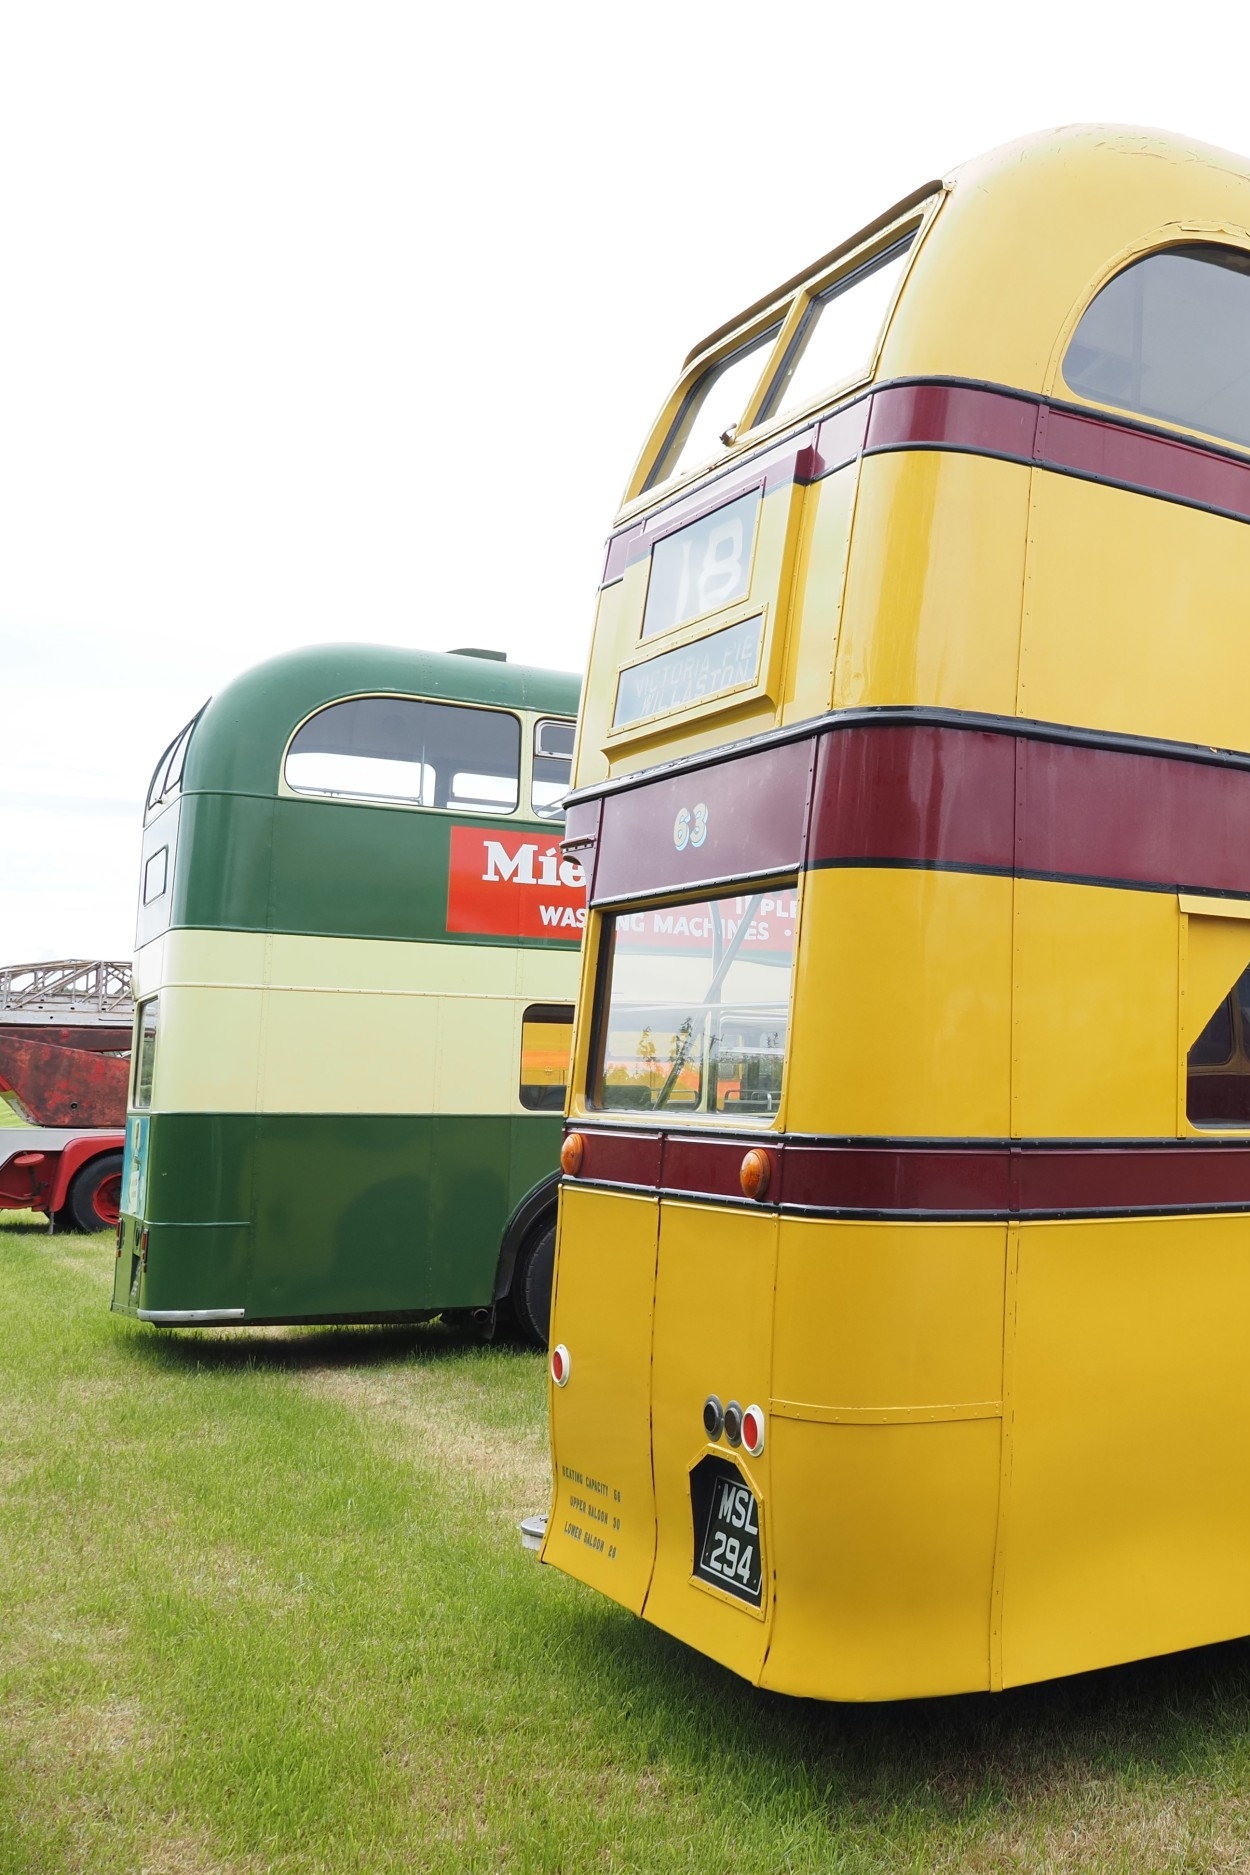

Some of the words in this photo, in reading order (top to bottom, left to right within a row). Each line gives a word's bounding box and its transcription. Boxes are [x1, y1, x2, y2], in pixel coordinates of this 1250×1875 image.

[675, 516, 744, 626] 18
[636, 653, 710, 696] VICTORIA
[640, 660, 750, 717] WILLASTON
[673, 803, 708, 851] 63
[562, 1465, 584, 1486] SEATING
[585, 1476, 609, 1497] CAPACITY
[569, 1495, 587, 1514] UPPER
[588, 1504, 609, 1525] SALOON
[717, 1483, 758, 1536] MSL
[563, 1520, 582, 1541] LOWER
[583, 1531, 605, 1553] SALOON
[709, 1531, 754, 1585] 294
